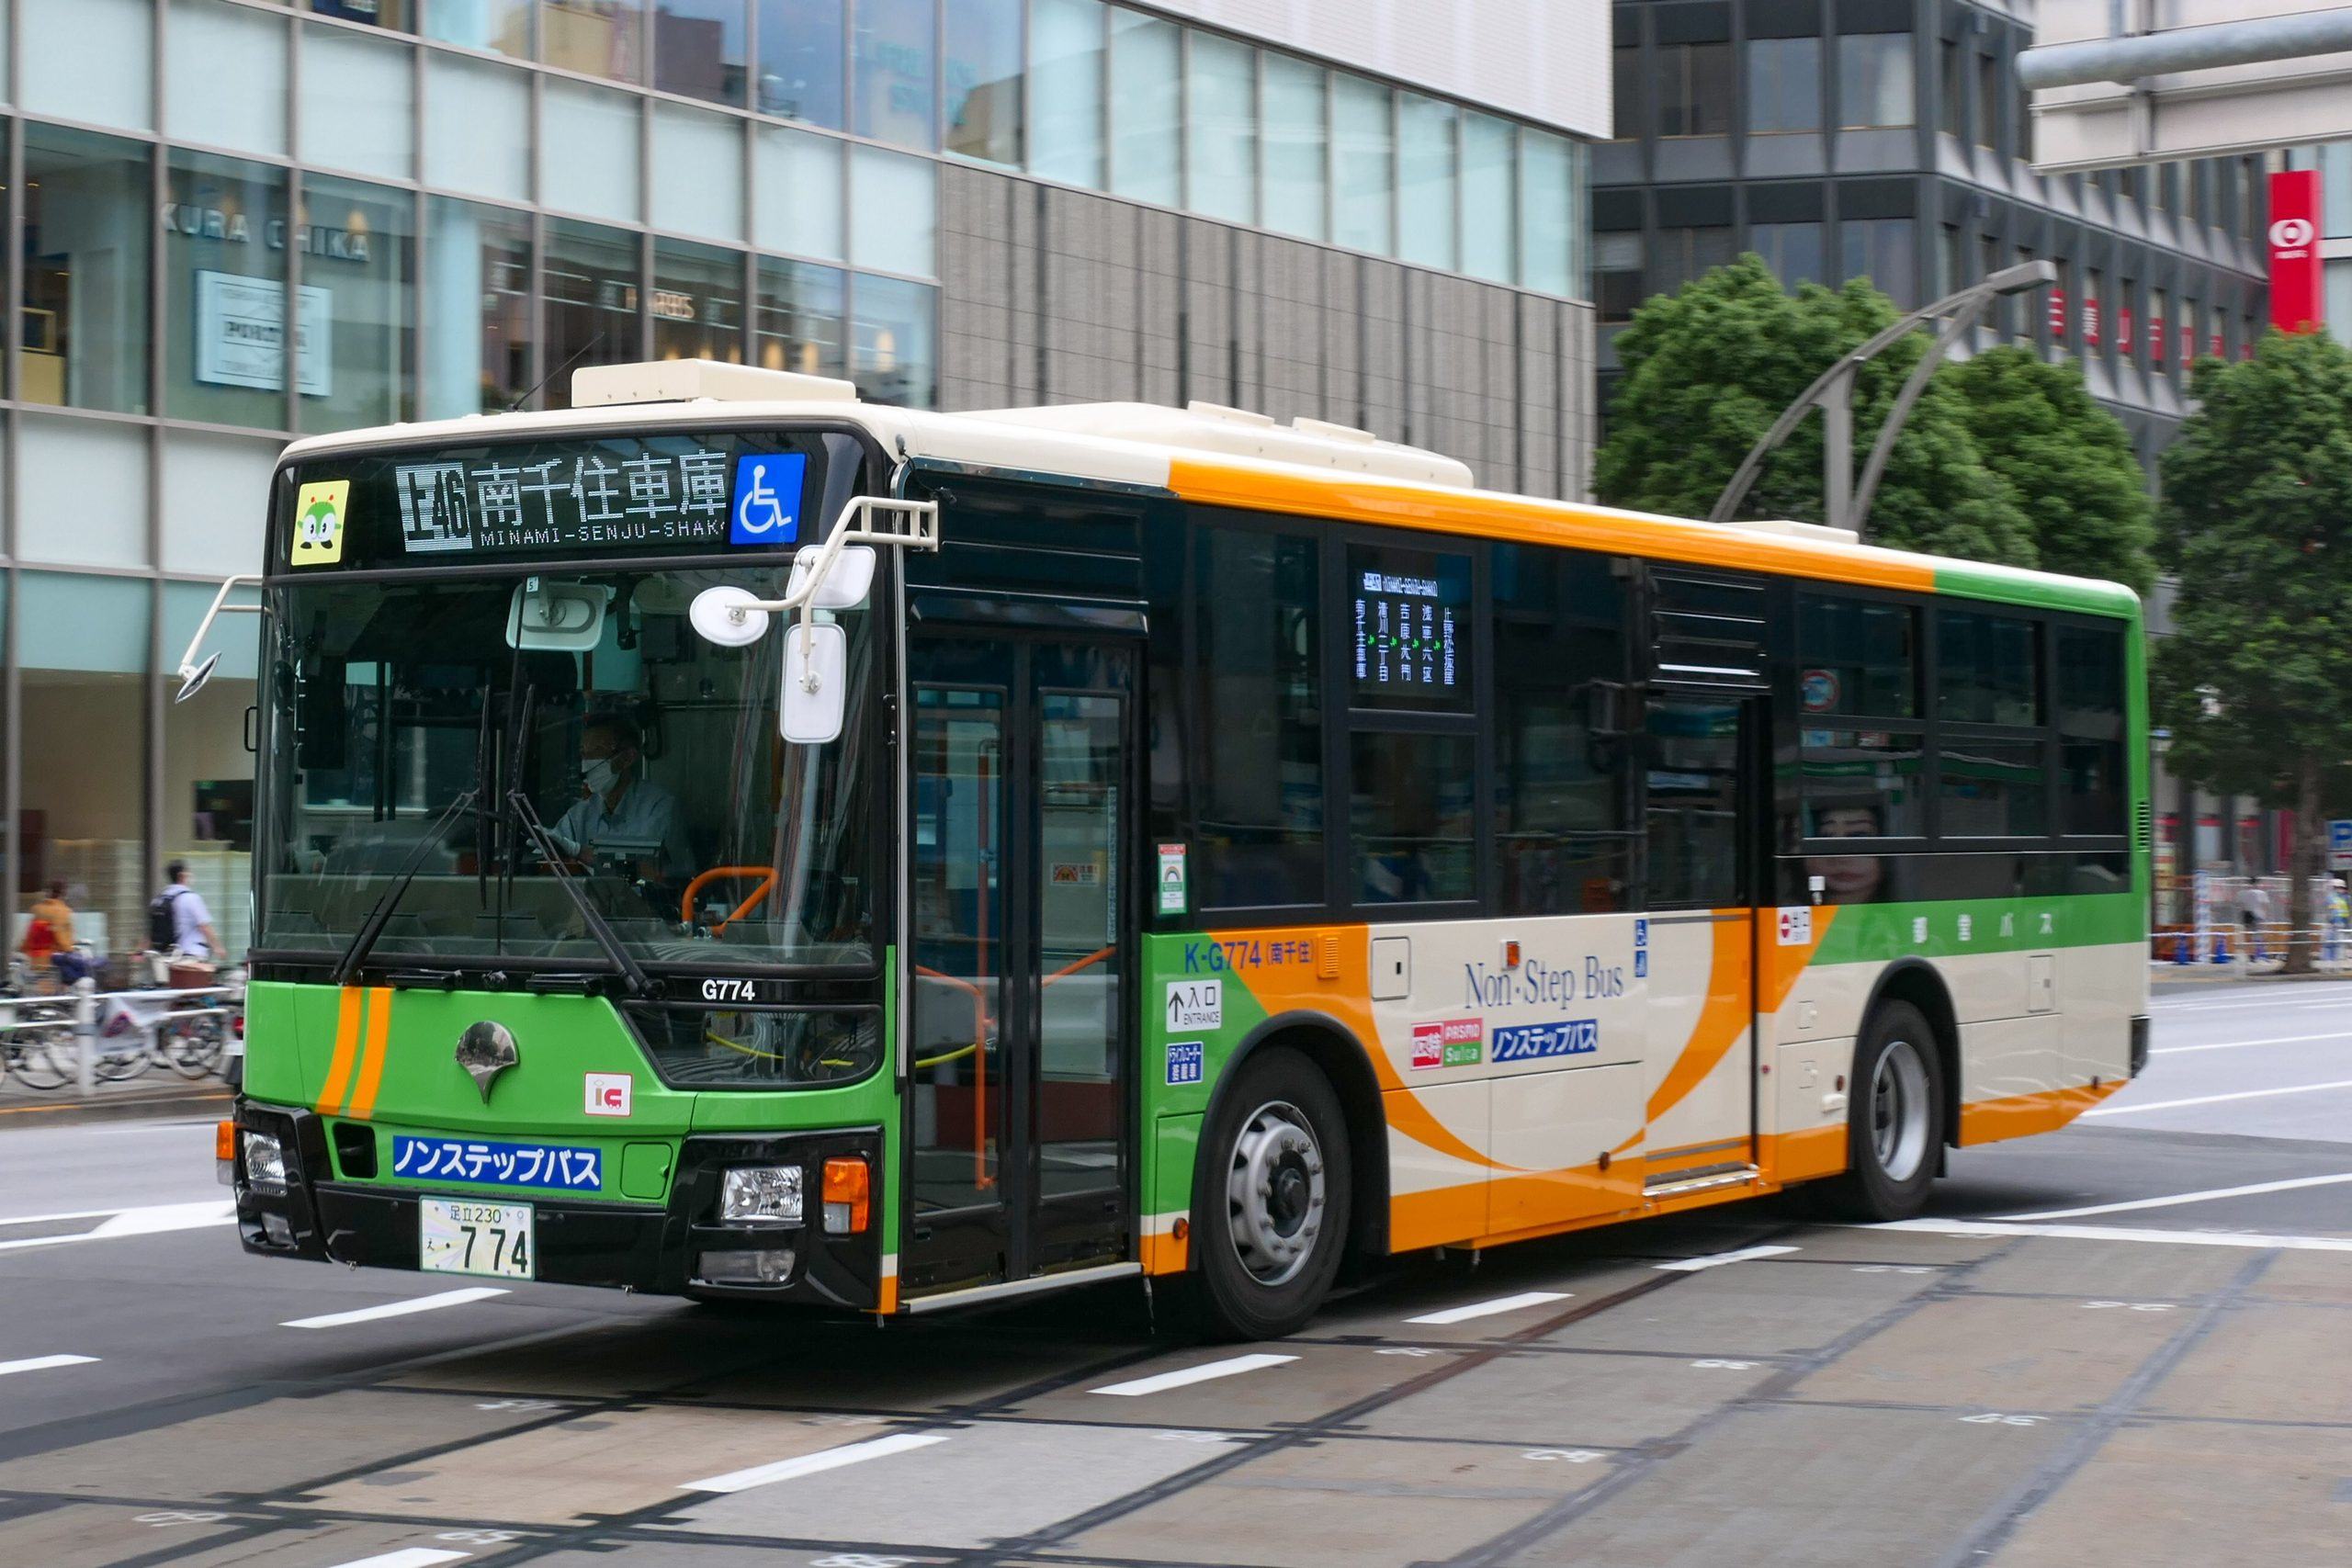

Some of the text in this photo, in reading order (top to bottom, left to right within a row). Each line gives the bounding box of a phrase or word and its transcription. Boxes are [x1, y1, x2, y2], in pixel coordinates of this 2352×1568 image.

[161, 202, 249, 243] KURA
[471, 449, 726, 526] 南千住車庫
[1400, 603, 1411, 681] 吉原大門
[1185, 941, 1261, 973] K-G774
[702, 979, 755, 1001] G774
[1585, 955, 1623, 998] Bus
[1188, 987, 1216, 1008] 入口
[1183, 1011, 1220, 1025] ENTRANCE
[1444, 1022, 1480, 1040] PASMO
[1445, 1046, 1478, 1063] Suica
[1492, 1023, 1598, 1059] ノンステップバス
[394, 1139, 600, 1187] ノンステップバス
[461, 1225, 527, 1273] 774
